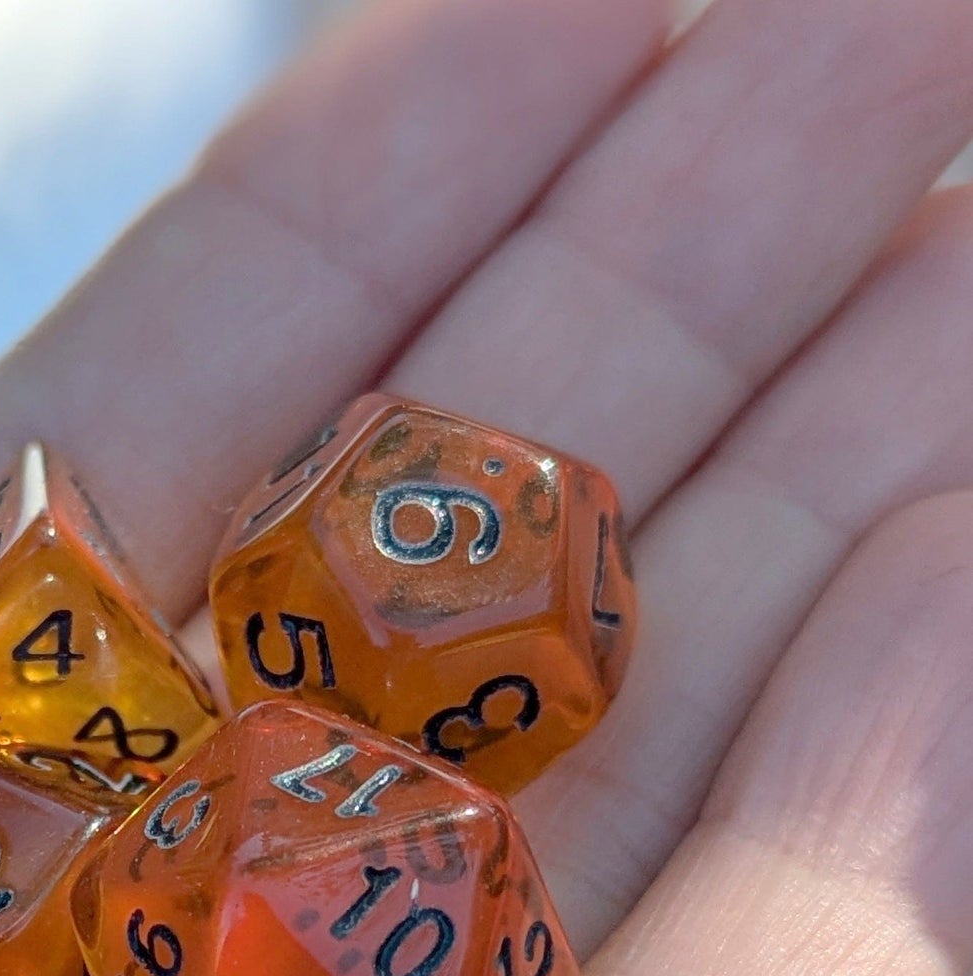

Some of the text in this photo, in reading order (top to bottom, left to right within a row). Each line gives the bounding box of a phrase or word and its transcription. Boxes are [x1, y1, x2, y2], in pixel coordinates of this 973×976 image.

[12, 609, 84, 677] 4
[246, 612, 337, 690] 5
[422, 674, 540, 763] 3
[144, 779, 211, 850] 3
[270, 743, 403, 820] 17
